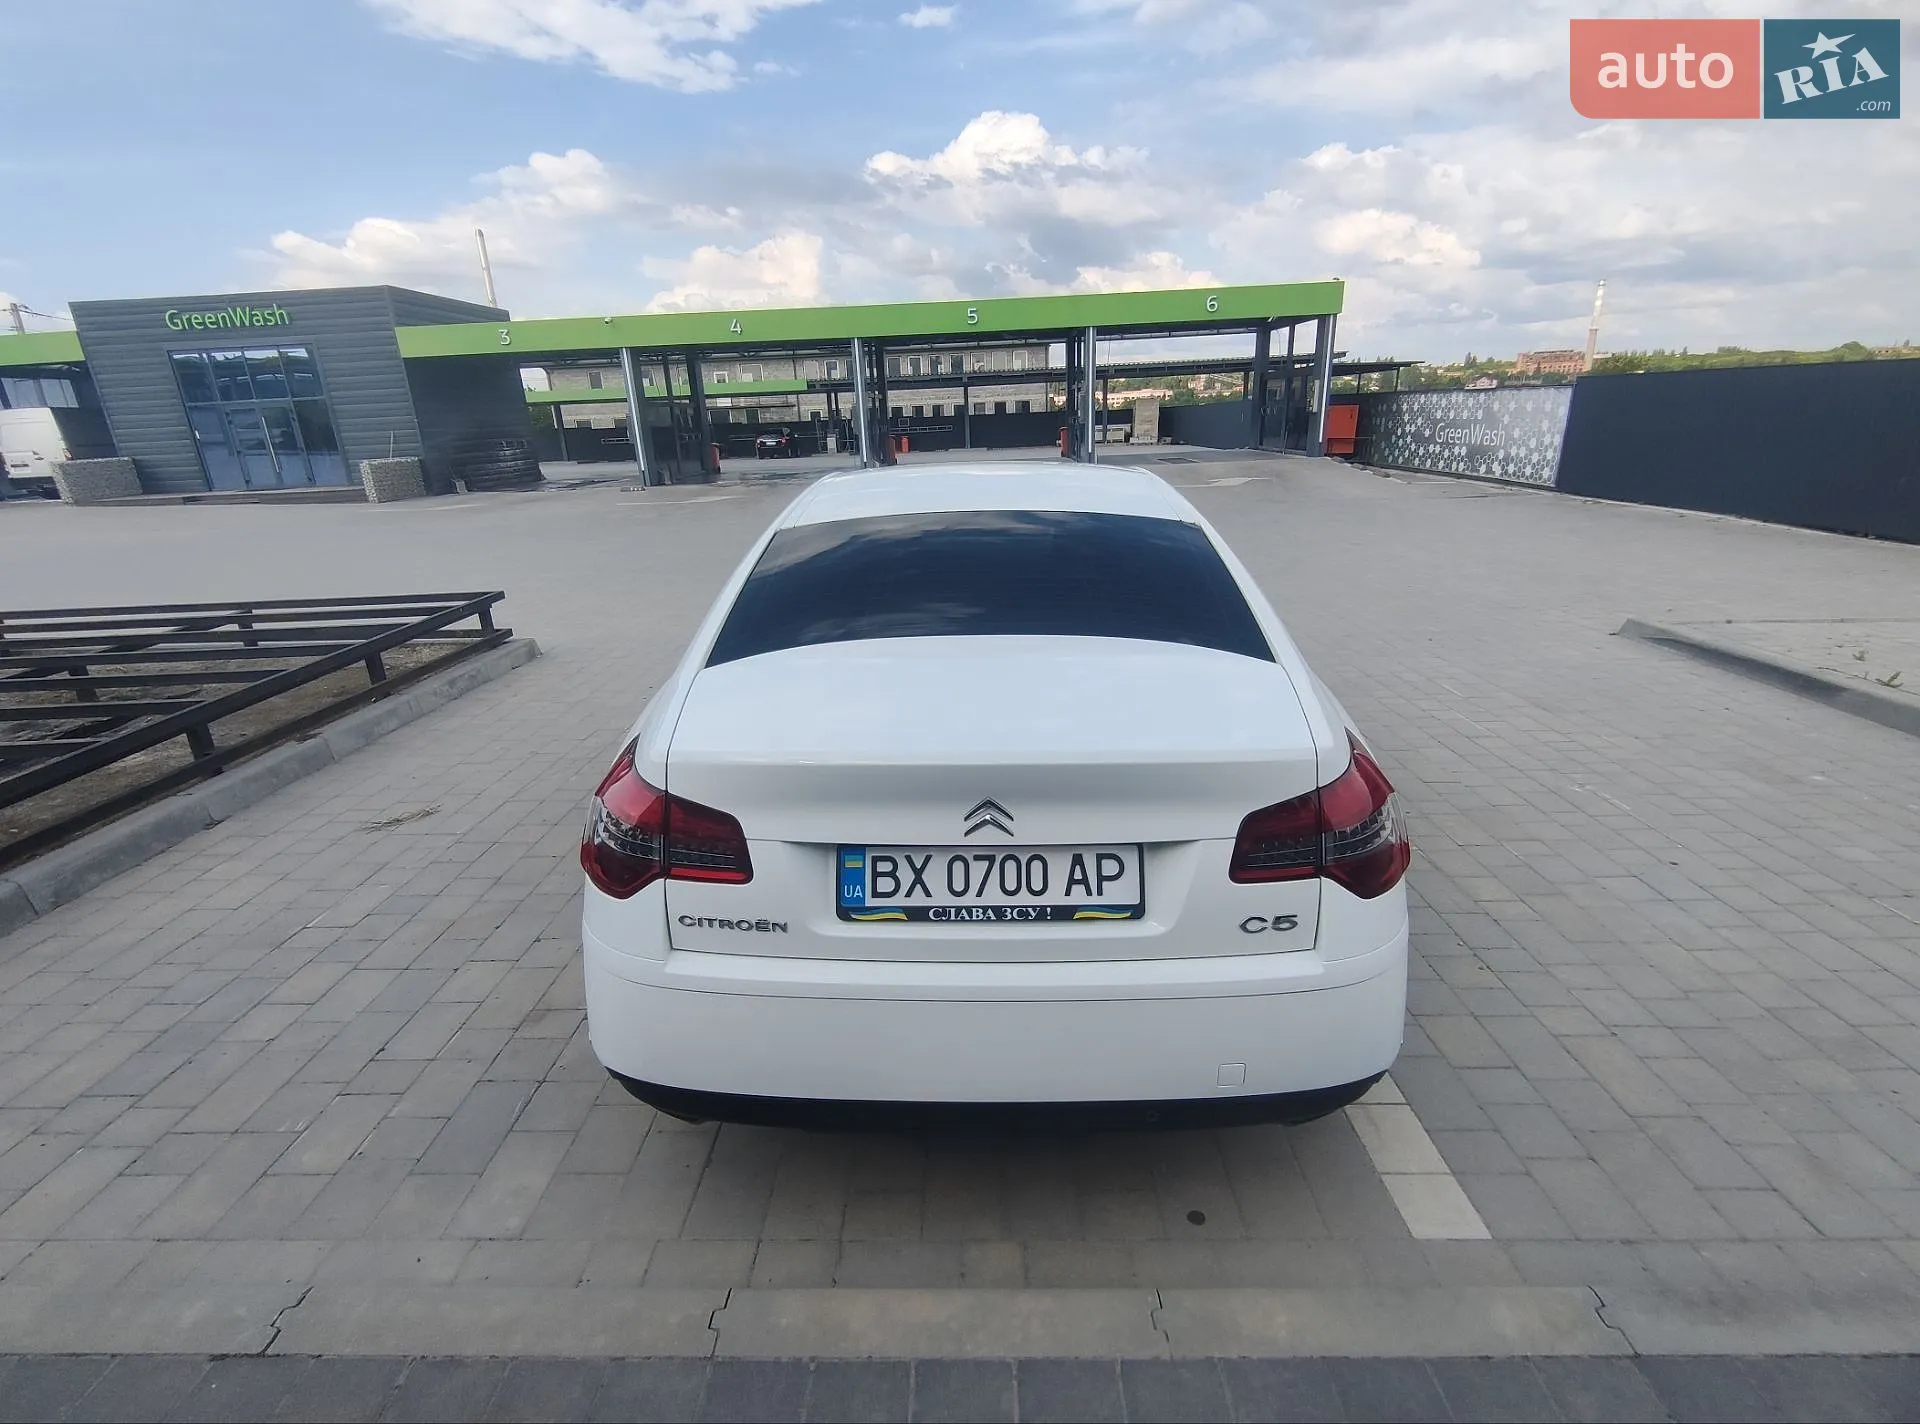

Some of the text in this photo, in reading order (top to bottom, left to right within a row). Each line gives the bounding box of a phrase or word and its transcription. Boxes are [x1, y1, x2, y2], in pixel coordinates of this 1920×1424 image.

[1206, 295, 1218, 312] 6
[165, 303, 290, 330] GreenWash
[967, 307, 978, 324] 5
[730, 318, 742, 334] 4
[498, 329, 510, 345] 3
[1435, 422, 1506, 447] GreenWash
[870, 852, 1125, 898] BX 0700 AP
[844, 884, 863, 898] UA
[928, 907, 997, 921] СЛАВА
[678, 915, 789, 933] CITROËN
[1240, 914, 1298, 934] C5
